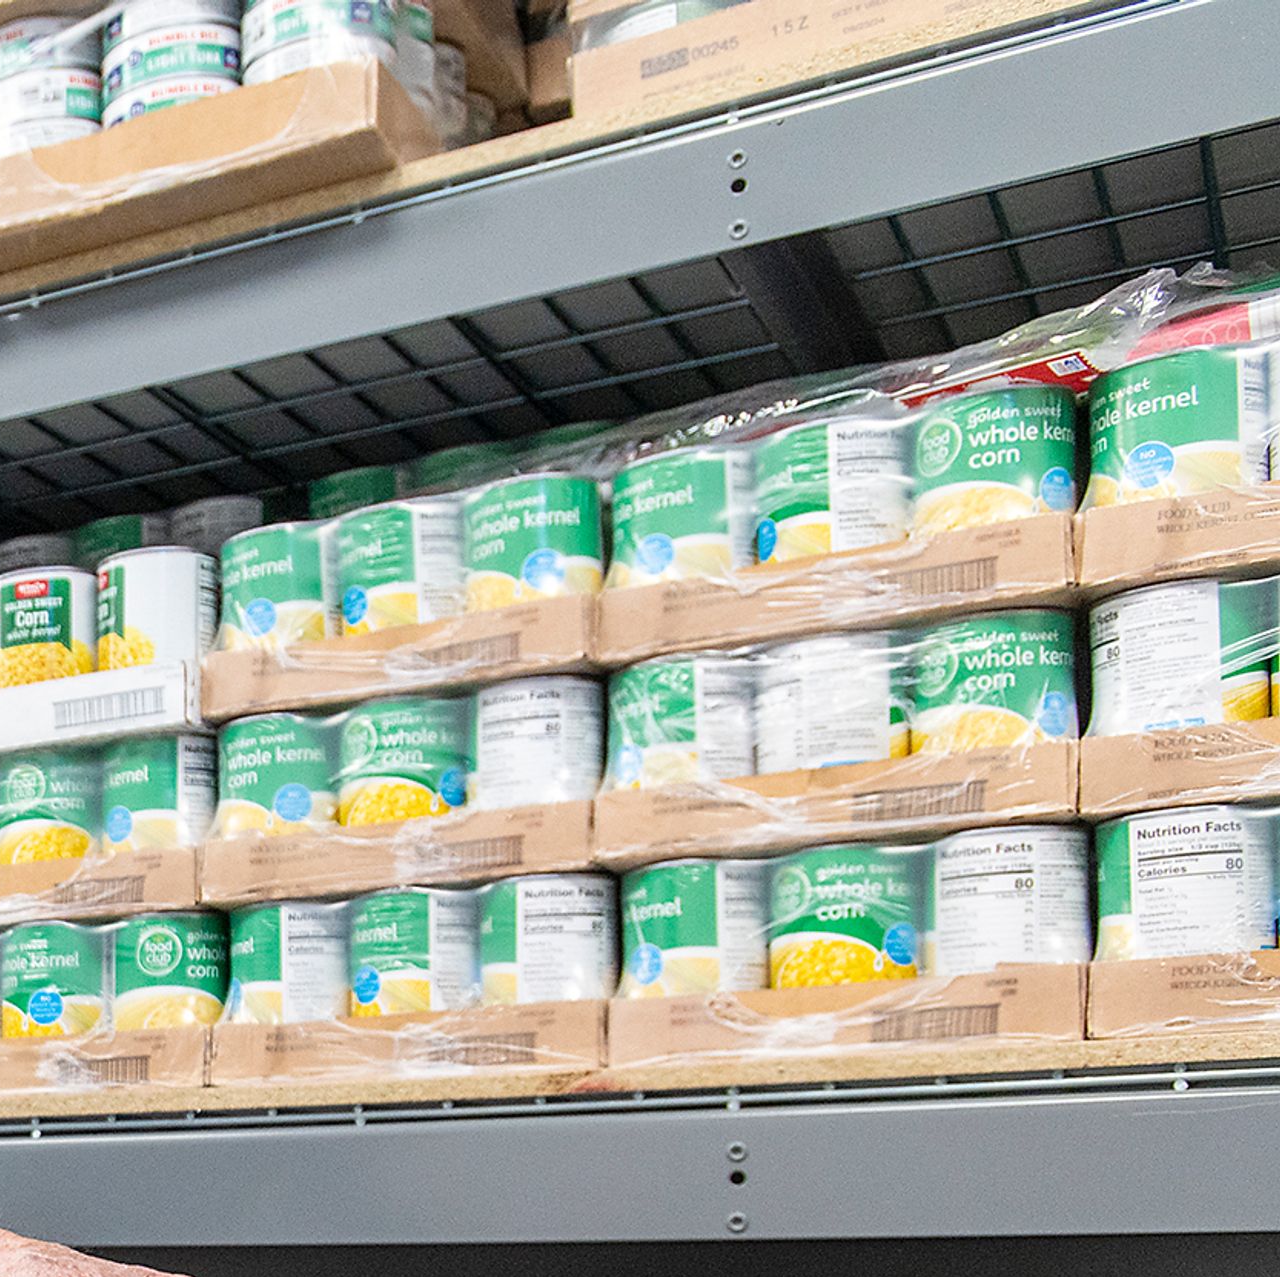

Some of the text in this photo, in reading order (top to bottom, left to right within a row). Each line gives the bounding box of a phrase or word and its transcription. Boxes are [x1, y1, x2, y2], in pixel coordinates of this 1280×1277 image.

[1108, 377, 1151, 403] sweet
[1125, 385, 1199, 421] kernel
[967, 403, 1061, 430] golden sweet
[968, 423, 1038, 448] whole
[968, 446, 1021, 470] corn
[1140, 449, 1157, 460] NO
[635, 485, 694, 512] kernel
[525, 507, 581, 531] kernel
[472, 538, 505, 560] corn
[15, 610, 49, 628] Corn
[965, 648, 1035, 671] whole
[1106, 645, 1121, 660] 80
[964, 672, 1016, 693] corn
[381, 728, 437, 747] whole
[228, 750, 272, 770] whole
[382, 748, 423, 765] corn
[228, 773, 258, 789] corn
[1137, 821, 1243, 840] Nutrition Facts
[995, 841, 1034, 855] Facts
[816, 863, 864, 881] golden
[1137, 857, 1244, 879] Calories 80
[814, 881, 883, 901] whole
[1014, 878, 1034, 891] 80
[816, 903, 867, 921] corn
[145, 941, 173, 954] food
[31, 949, 80, 969] kernel
[145, 952, 172, 966] club
[187, 963, 219, 978] corn
